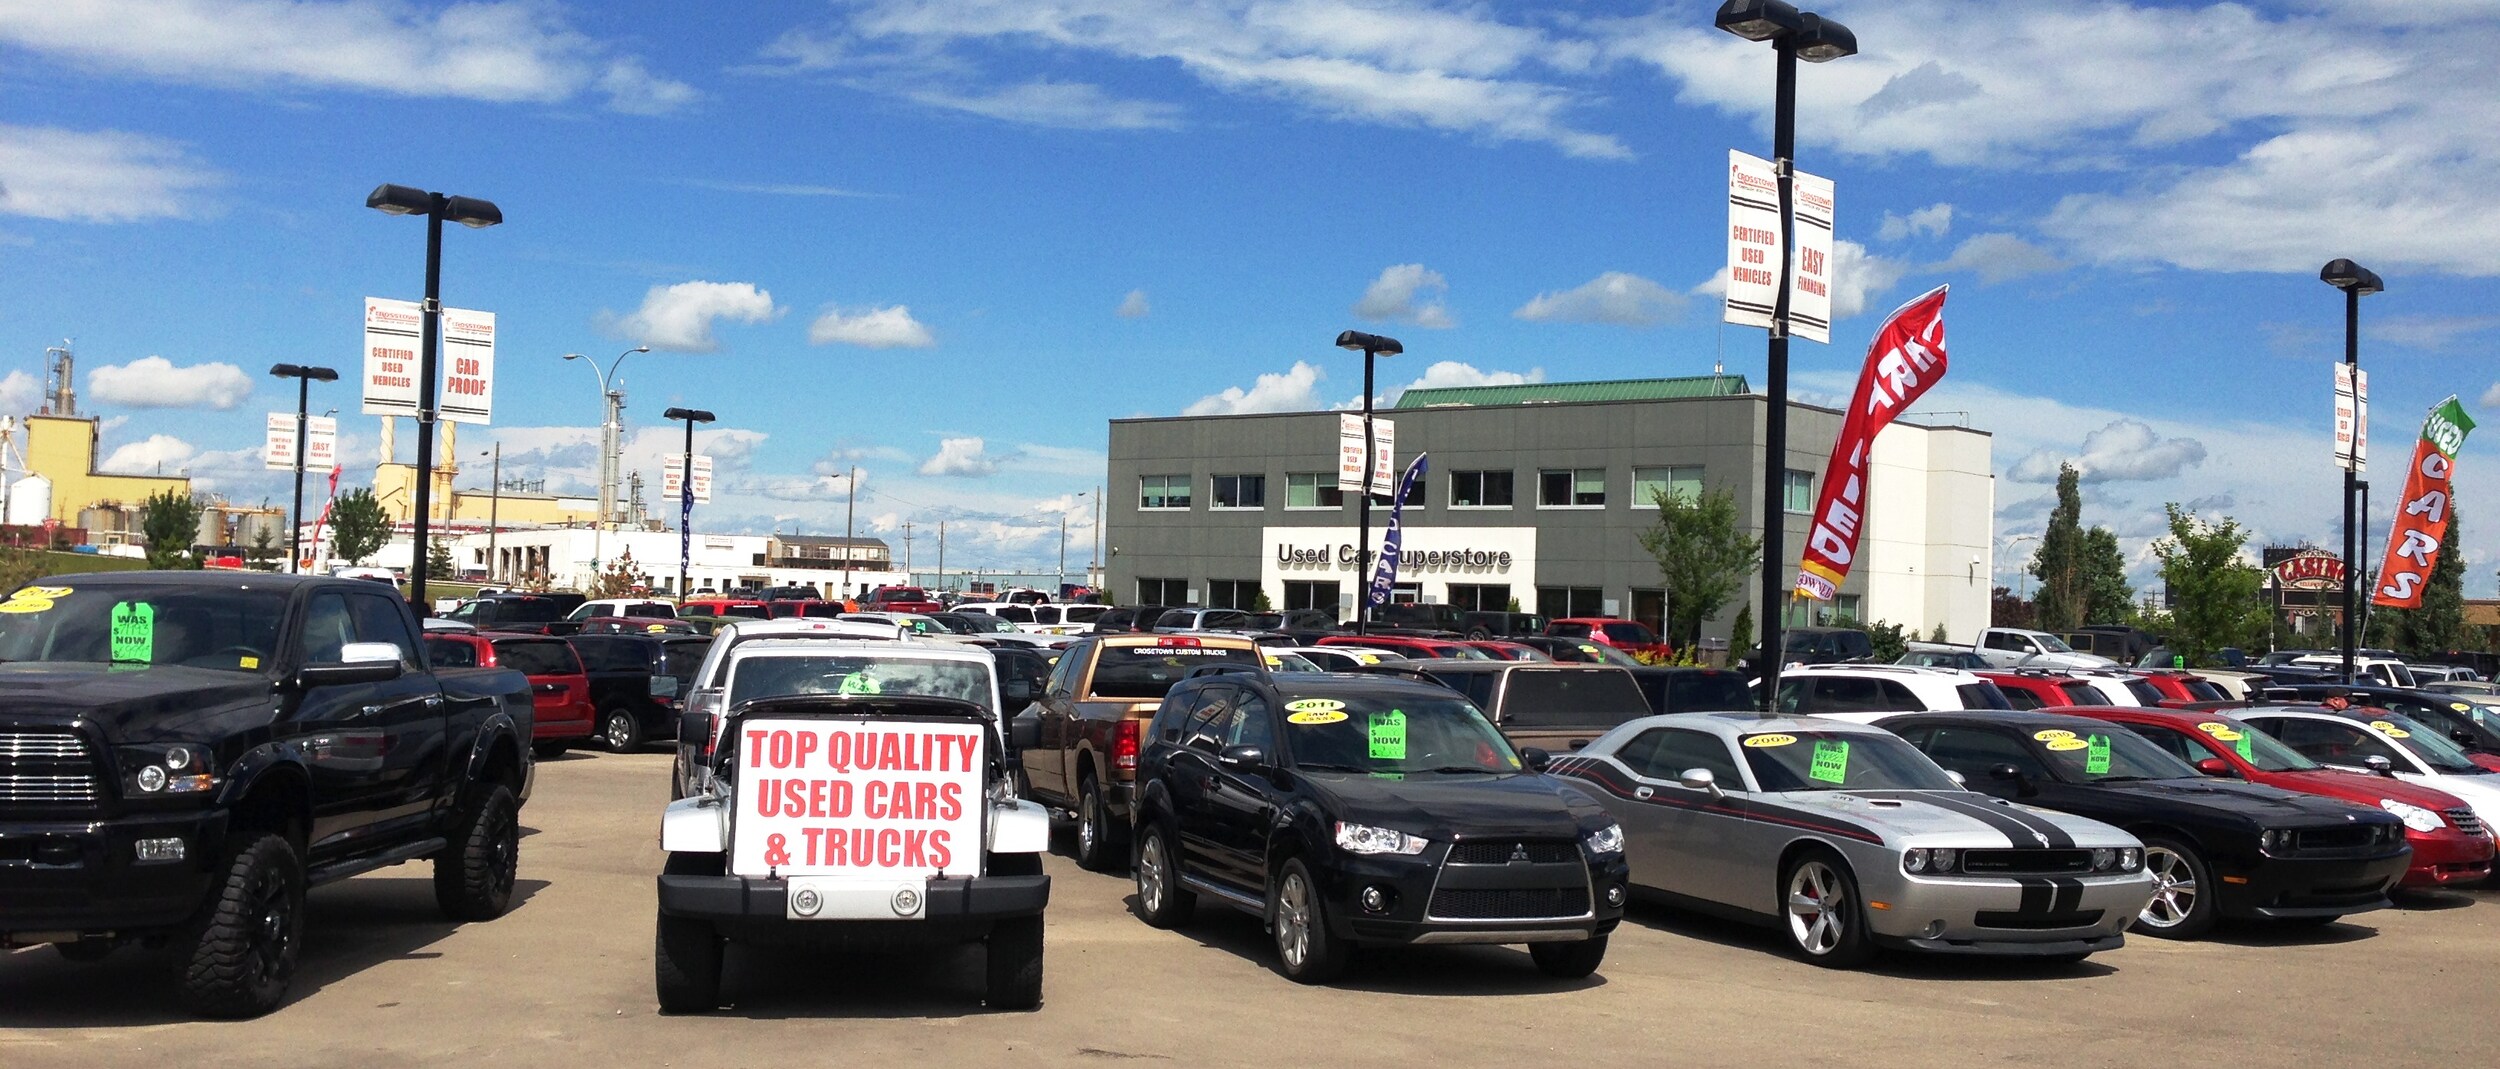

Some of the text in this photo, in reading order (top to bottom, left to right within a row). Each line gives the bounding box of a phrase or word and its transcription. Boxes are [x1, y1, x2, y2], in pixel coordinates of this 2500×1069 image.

[1737, 172, 1777, 189] CROSSTOWN
[1733, 225, 1775, 246] CERTIFIED
[1742, 247, 1765, 265] USED
[1802, 246, 1825, 277] EASY
[1733, 266, 1772, 287] VEHICLES
[1797, 275, 1827, 297] FINANCING
[372, 346, 414, 361] CERTIFIED
[381, 361, 403, 374] USED
[455, 357, 480, 376] CAR
[372, 374, 411, 388] VEHICLES
[447, 376, 486, 396] PROOF
[2426, 413, 2464, 456] USED
[312, 441, 330, 452] EASY
[2382, 452, 2449, 600] CARS
[1278, 543, 1330, 563] Used
[1399, 546, 1512, 569] uperstore
[117, 615, 147, 624] WAS
[116, 636, 146, 645] NOW
[1175, 648, 1201, 656] CUSTOM
[1295, 701, 1335, 709] 2011
[1374, 718, 1401, 726] WAS
[1373, 736, 1401, 745] NOW
[1751, 736, 1790, 746] 2009
[2040, 731, 2070, 740] 2010
[746, 729, 979, 774] TOP QUALITY
[1820, 743, 1844, 754] WAS
[1815, 760, 1842, 770] NOW
[757, 778, 962, 821] USED CARS
[763, 827, 952, 868] & TRUCKS
